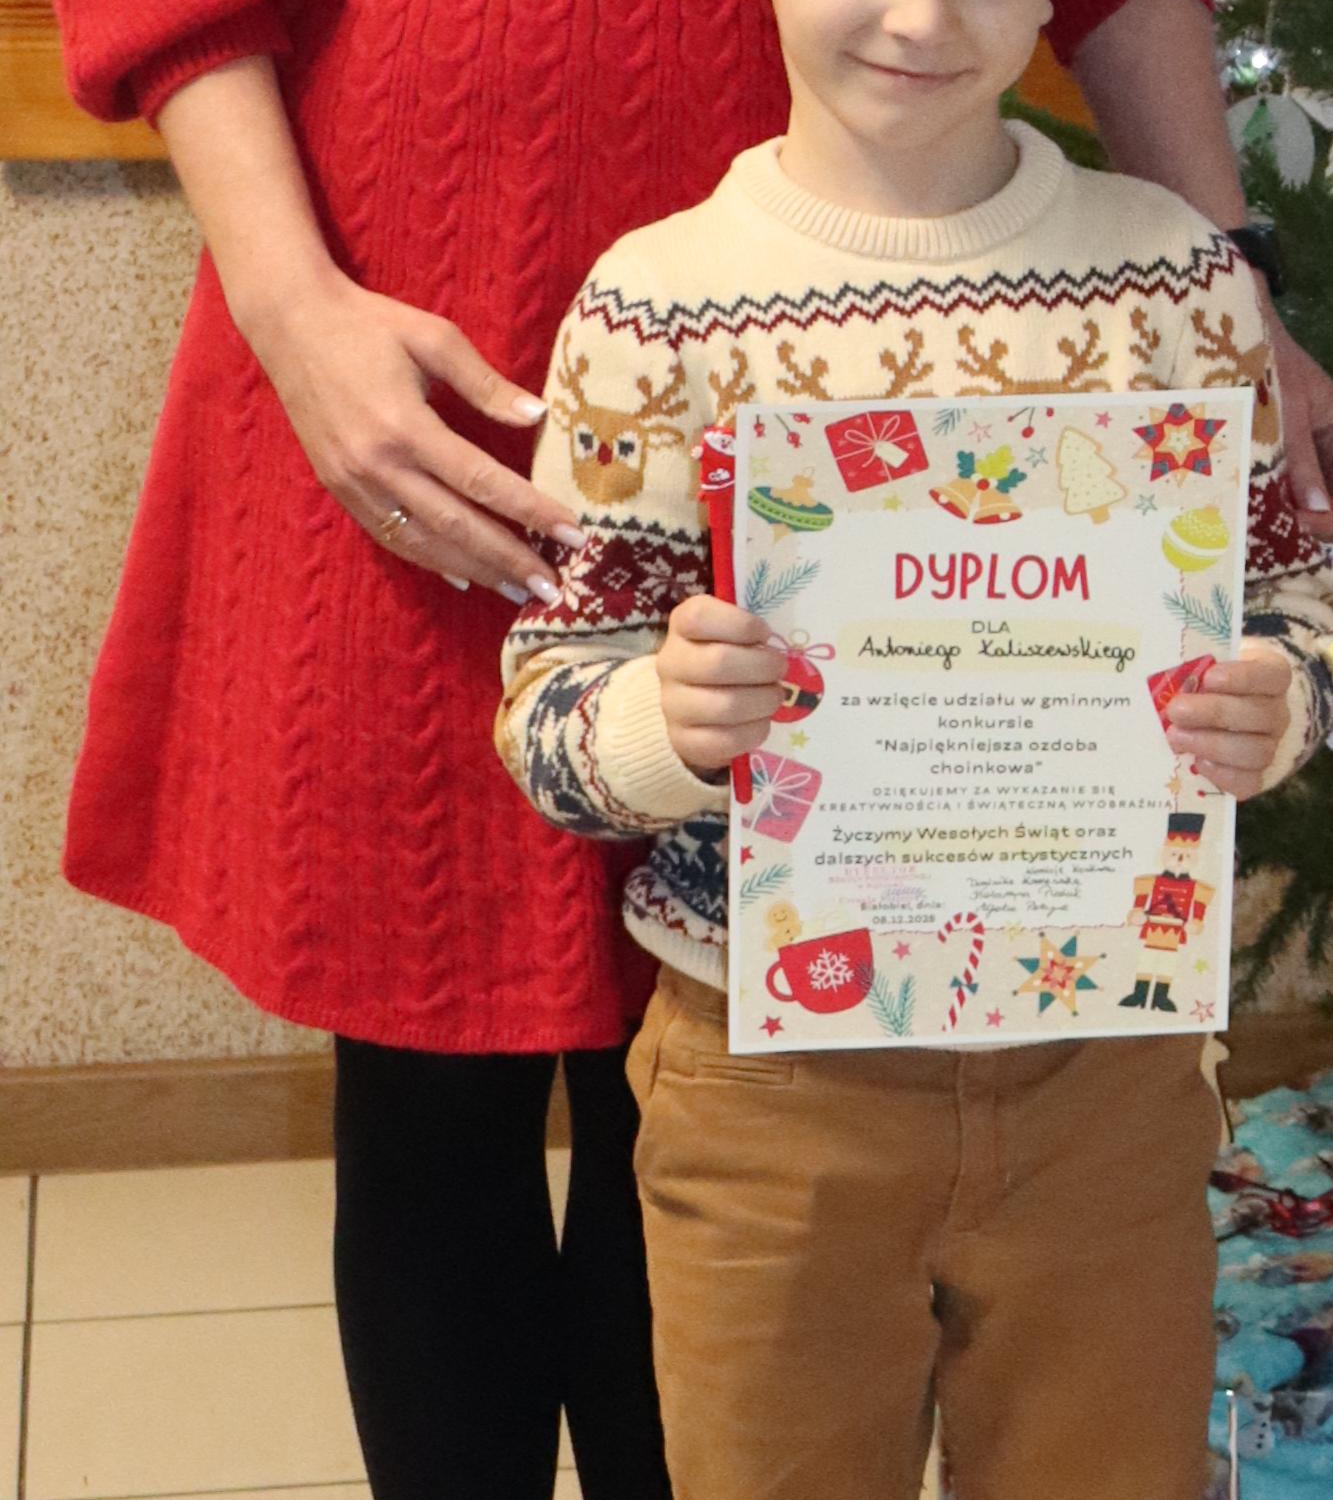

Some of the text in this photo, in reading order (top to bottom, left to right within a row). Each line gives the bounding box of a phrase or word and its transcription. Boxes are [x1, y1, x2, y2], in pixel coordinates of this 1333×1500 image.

[895, 553, 1090, 600] DYPLOM
[971, 620, 1011, 634] DLA
[841, 693, 1131, 709] za wzięcie udziału w gminnym
[938, 716, 1034, 729] konkursie
[1028, 738, 1097, 752] ozdoba
[832, 822, 1117, 843] Życzymy Wesołych Świąt oraz
[814, 847, 1133, 866] dalszych sukcesów artystycznych
